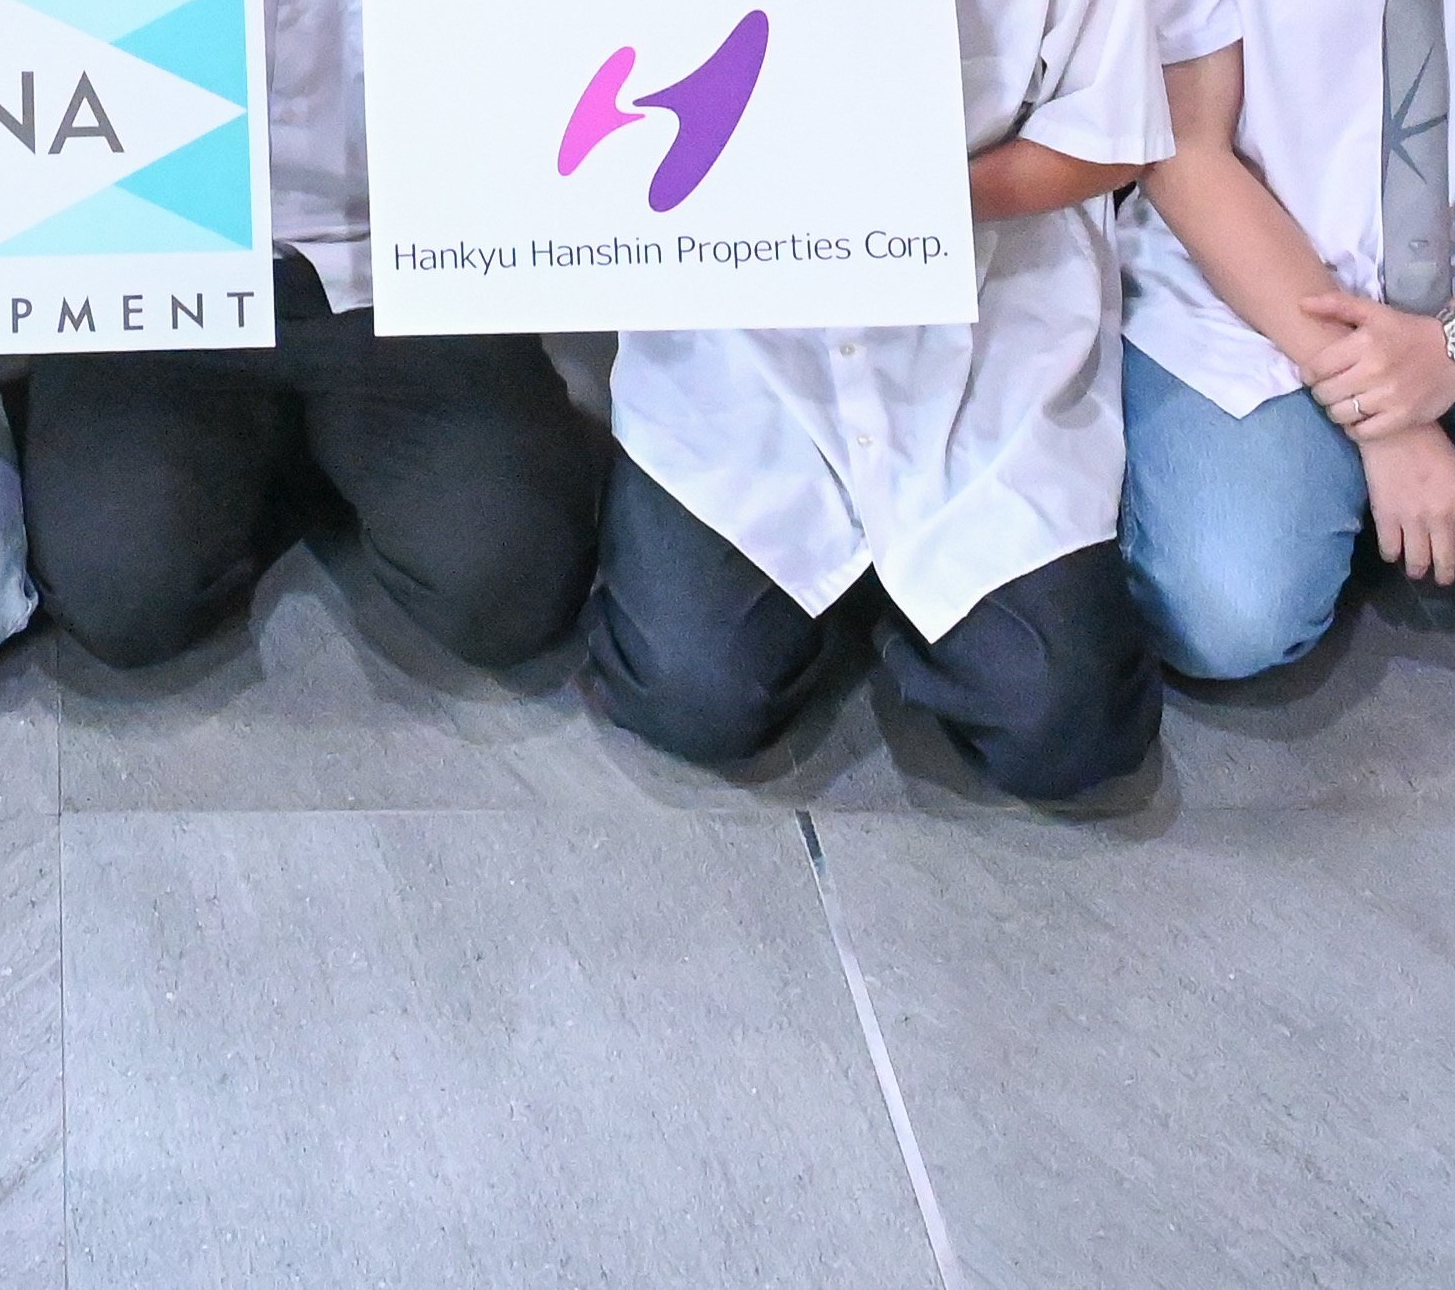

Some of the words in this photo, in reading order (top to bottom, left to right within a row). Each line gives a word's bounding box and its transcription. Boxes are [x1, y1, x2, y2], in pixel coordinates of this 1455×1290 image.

[394, 241, 518, 275] Hankyu
[531, 237, 663, 267] Hanshin
[677, 232, 852, 268] Properties
[864, 229, 950, 262] Corp.
